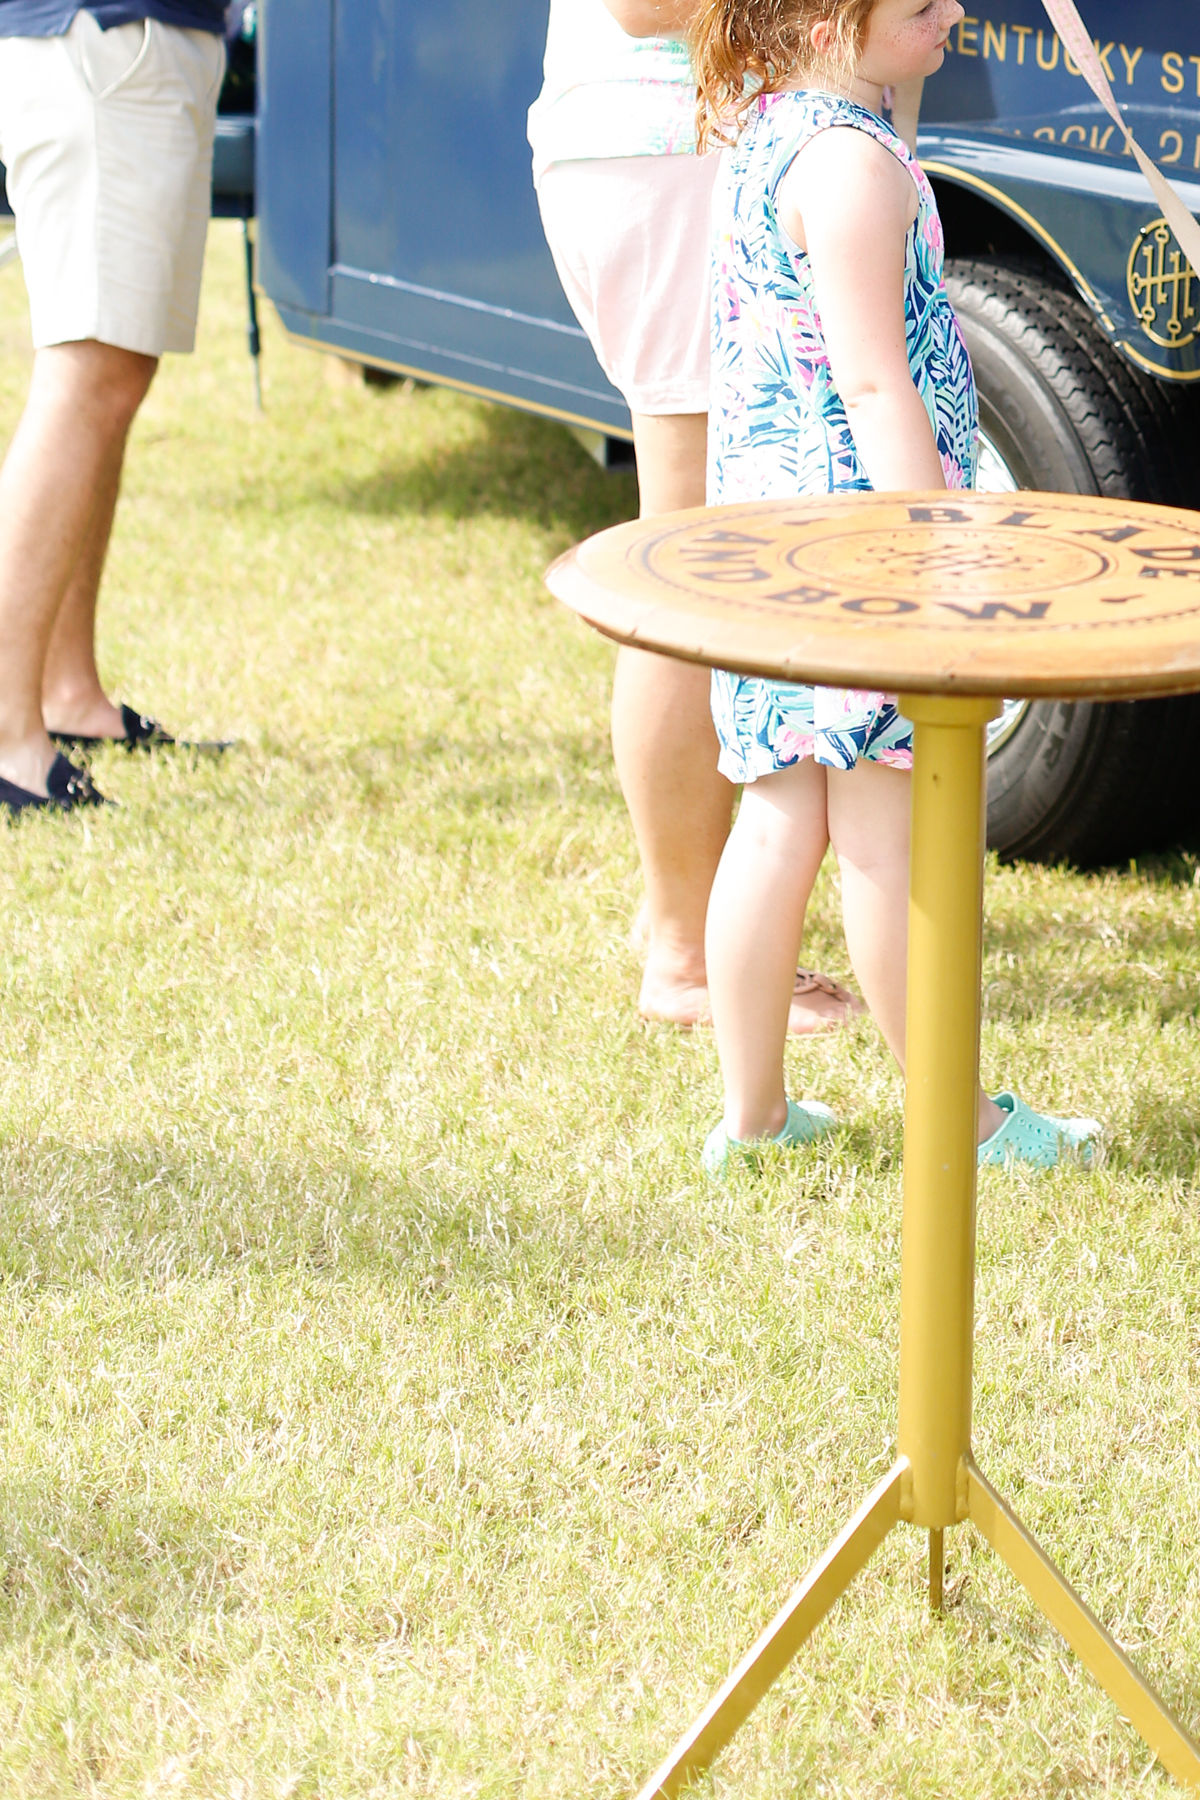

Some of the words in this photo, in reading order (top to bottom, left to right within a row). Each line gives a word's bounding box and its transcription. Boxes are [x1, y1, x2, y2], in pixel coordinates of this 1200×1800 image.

[945, 16, 1143, 85] ENTUKY
[679, 529, 776, 583] AND
[764, 586, 1053, 620] BOW
